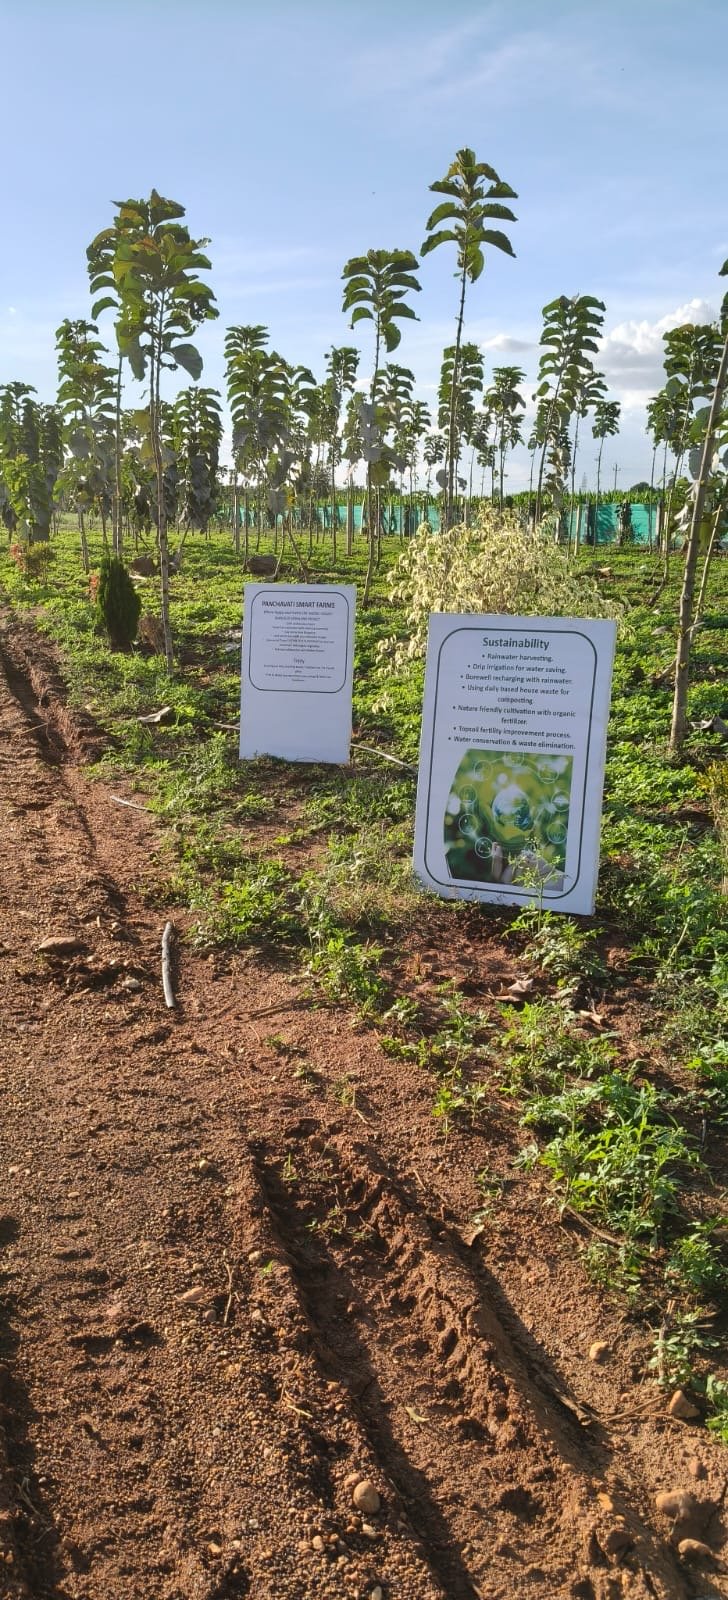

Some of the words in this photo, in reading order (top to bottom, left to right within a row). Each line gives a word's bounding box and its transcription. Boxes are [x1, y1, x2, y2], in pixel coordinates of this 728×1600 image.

[483, 637, 549, 651] Sustainability
[486, 664, 514, 672] irrigation
[493, 674, 524, 683] recharging
[468, 684, 483, 692] Using
[485, 685, 498, 693] daily
[480, 705, 502, 714] friendly
[504, 707, 535, 715] cultivation
[480, 726, 501, 735] fertility
[504, 728, 544, 737] improvement
[473, 736, 510, 744] conservation
[538, 741, 576, 750] elimination.
